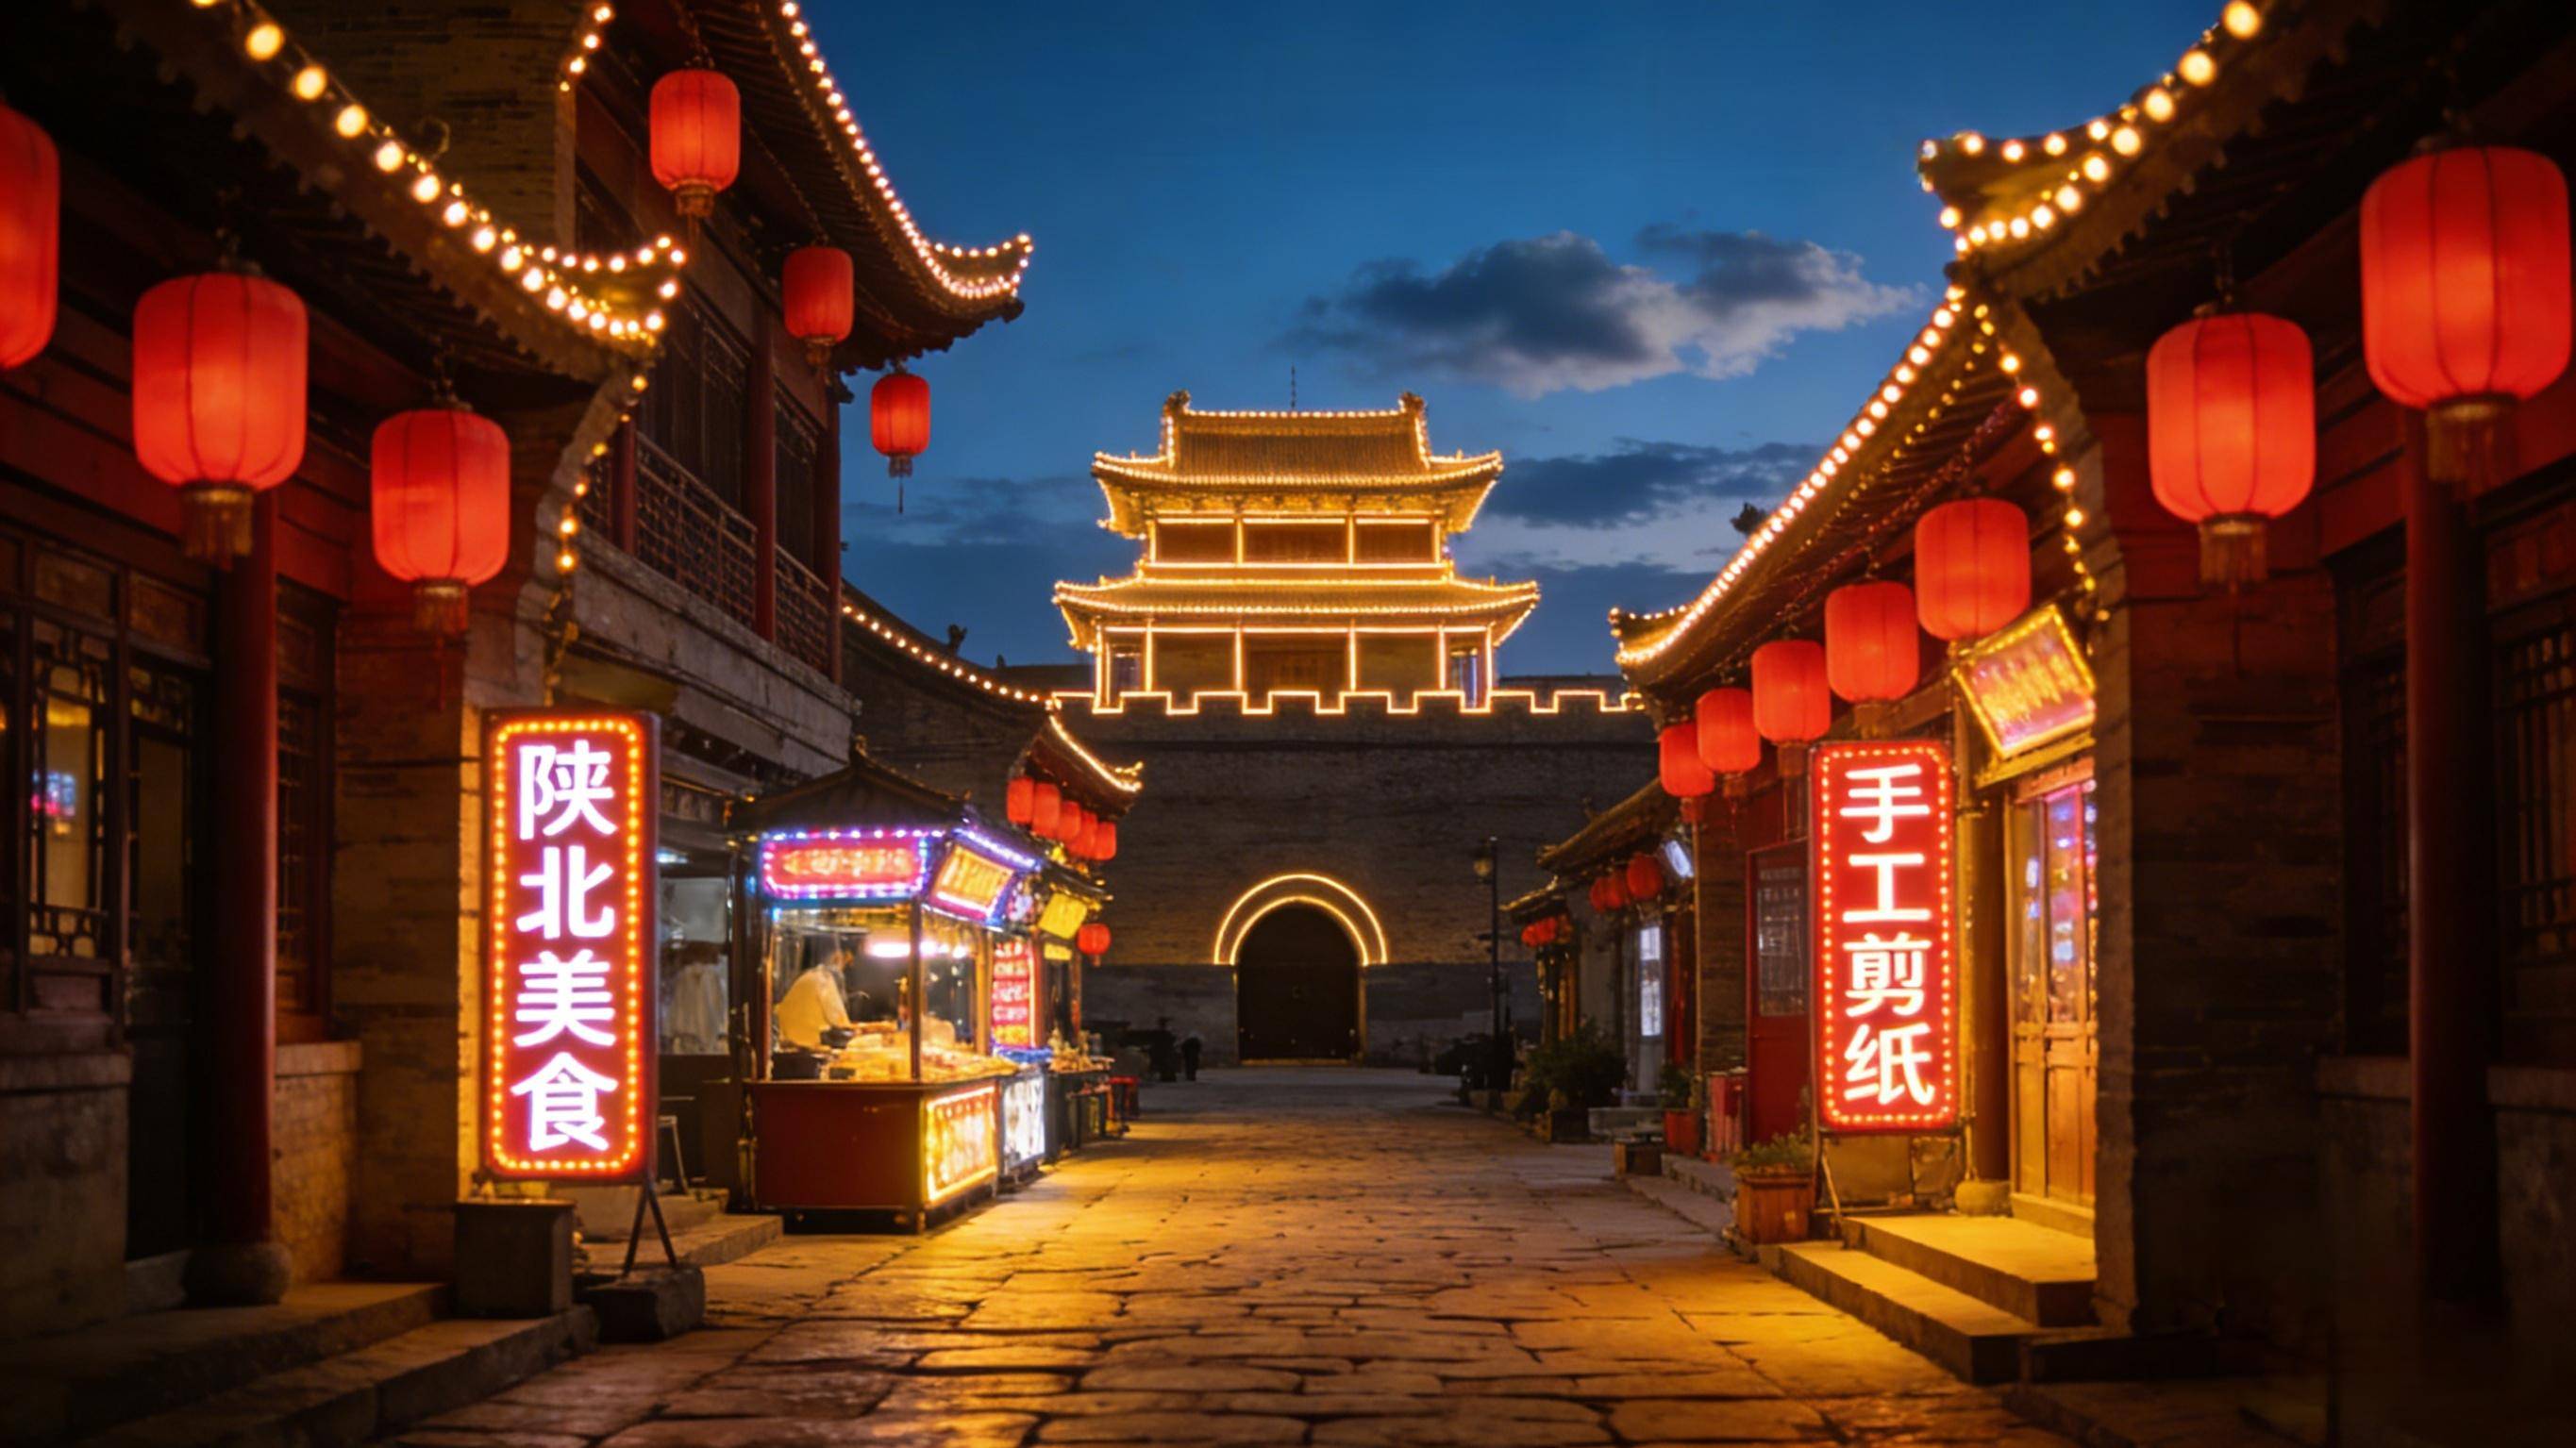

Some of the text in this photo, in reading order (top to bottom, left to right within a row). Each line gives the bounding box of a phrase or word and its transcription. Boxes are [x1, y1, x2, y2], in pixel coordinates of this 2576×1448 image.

[510, 740, 618, 1151] 陕北美食
[1839, 763, 1935, 1105] 手工剪纸
